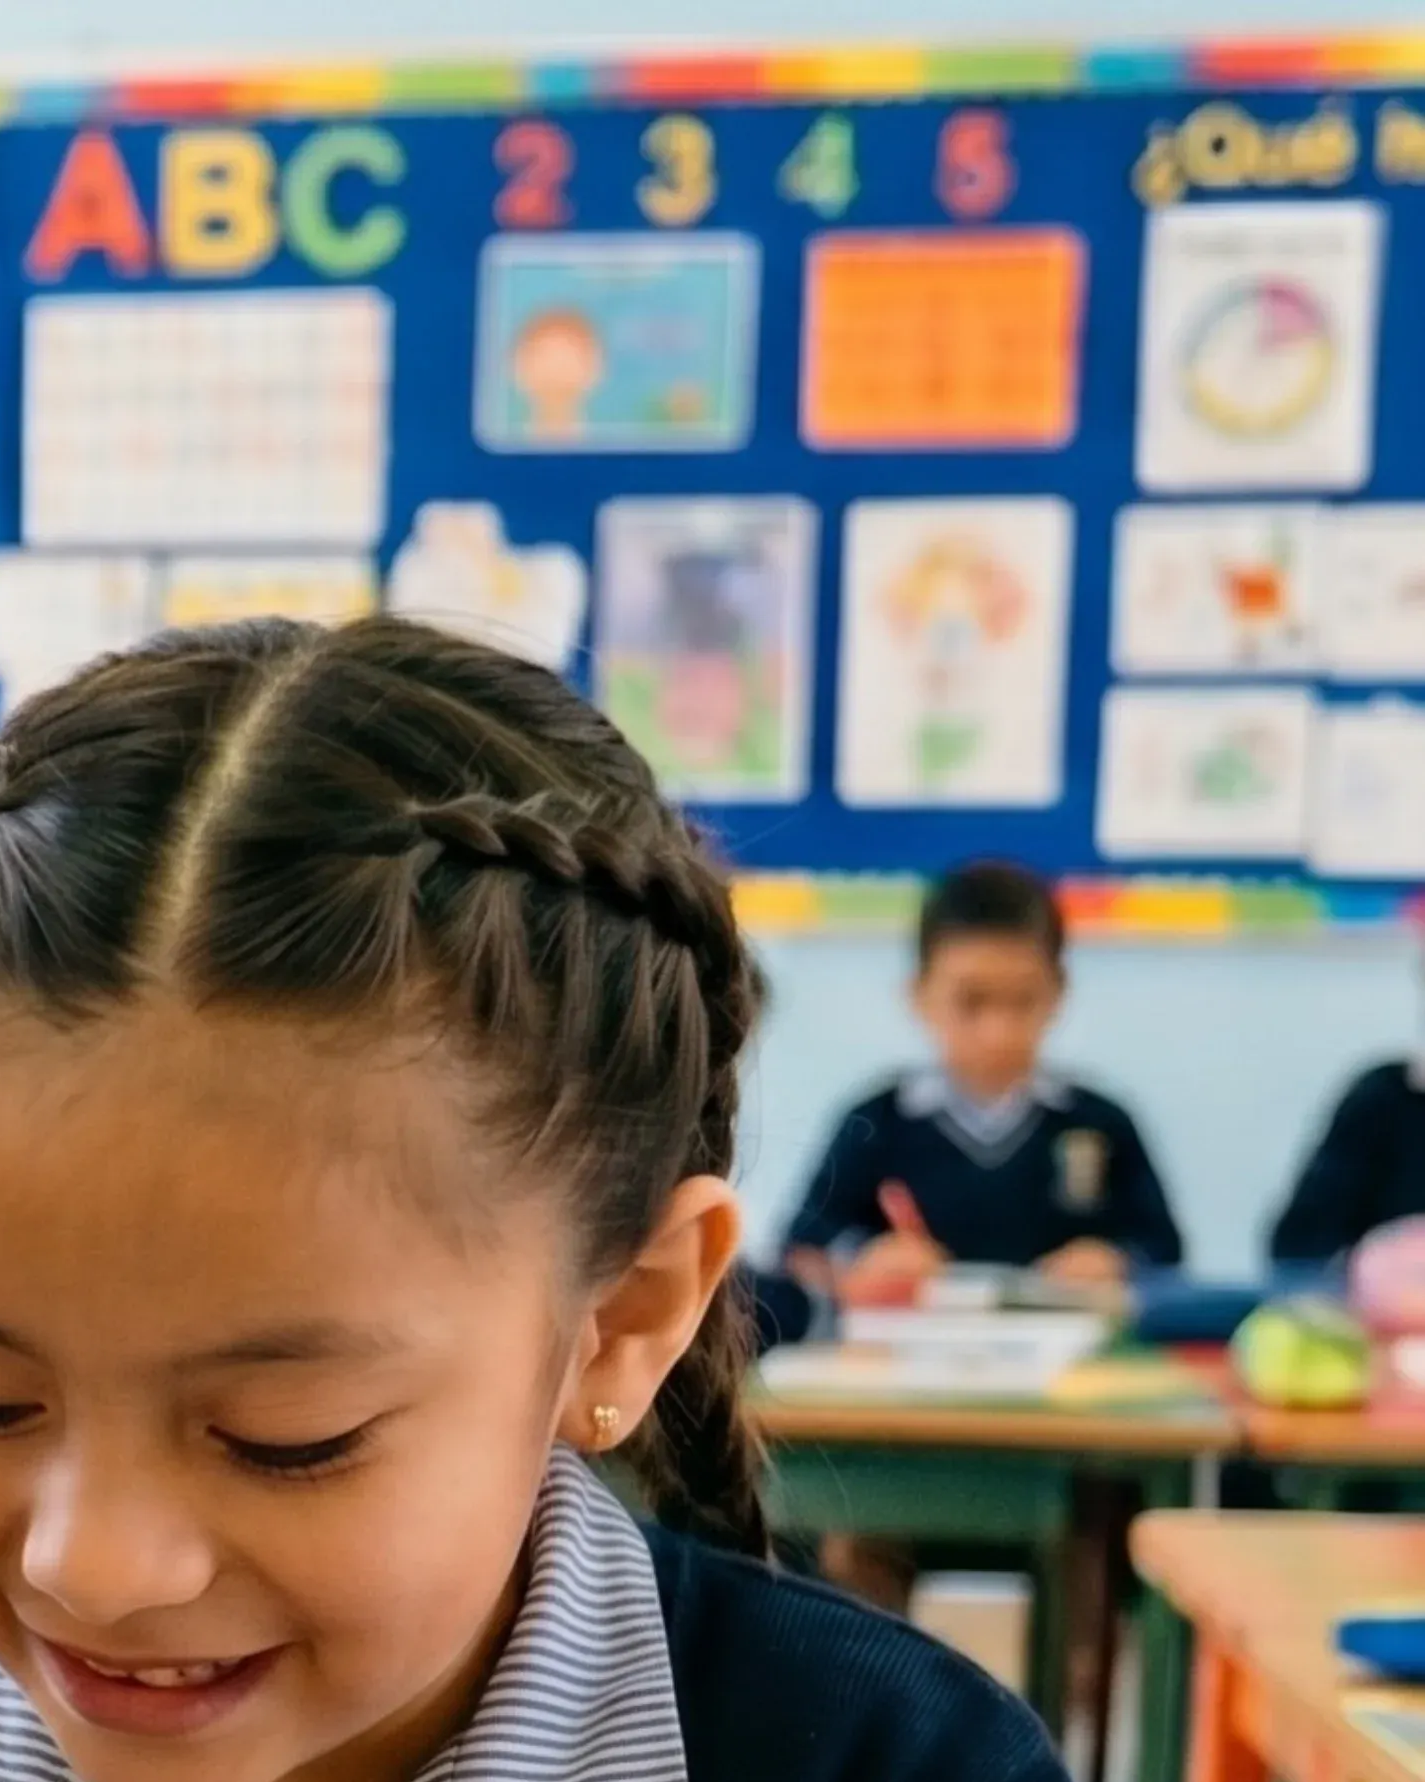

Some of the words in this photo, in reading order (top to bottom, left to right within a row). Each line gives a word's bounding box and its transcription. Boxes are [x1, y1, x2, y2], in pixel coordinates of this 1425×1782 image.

[22, 124, 406, 284] ABC
[492, 118, 575, 230] 2
[636, 112, 717, 227] 3
[777, 110, 859, 220] 4
[935, 107, 1018, 220] 5
